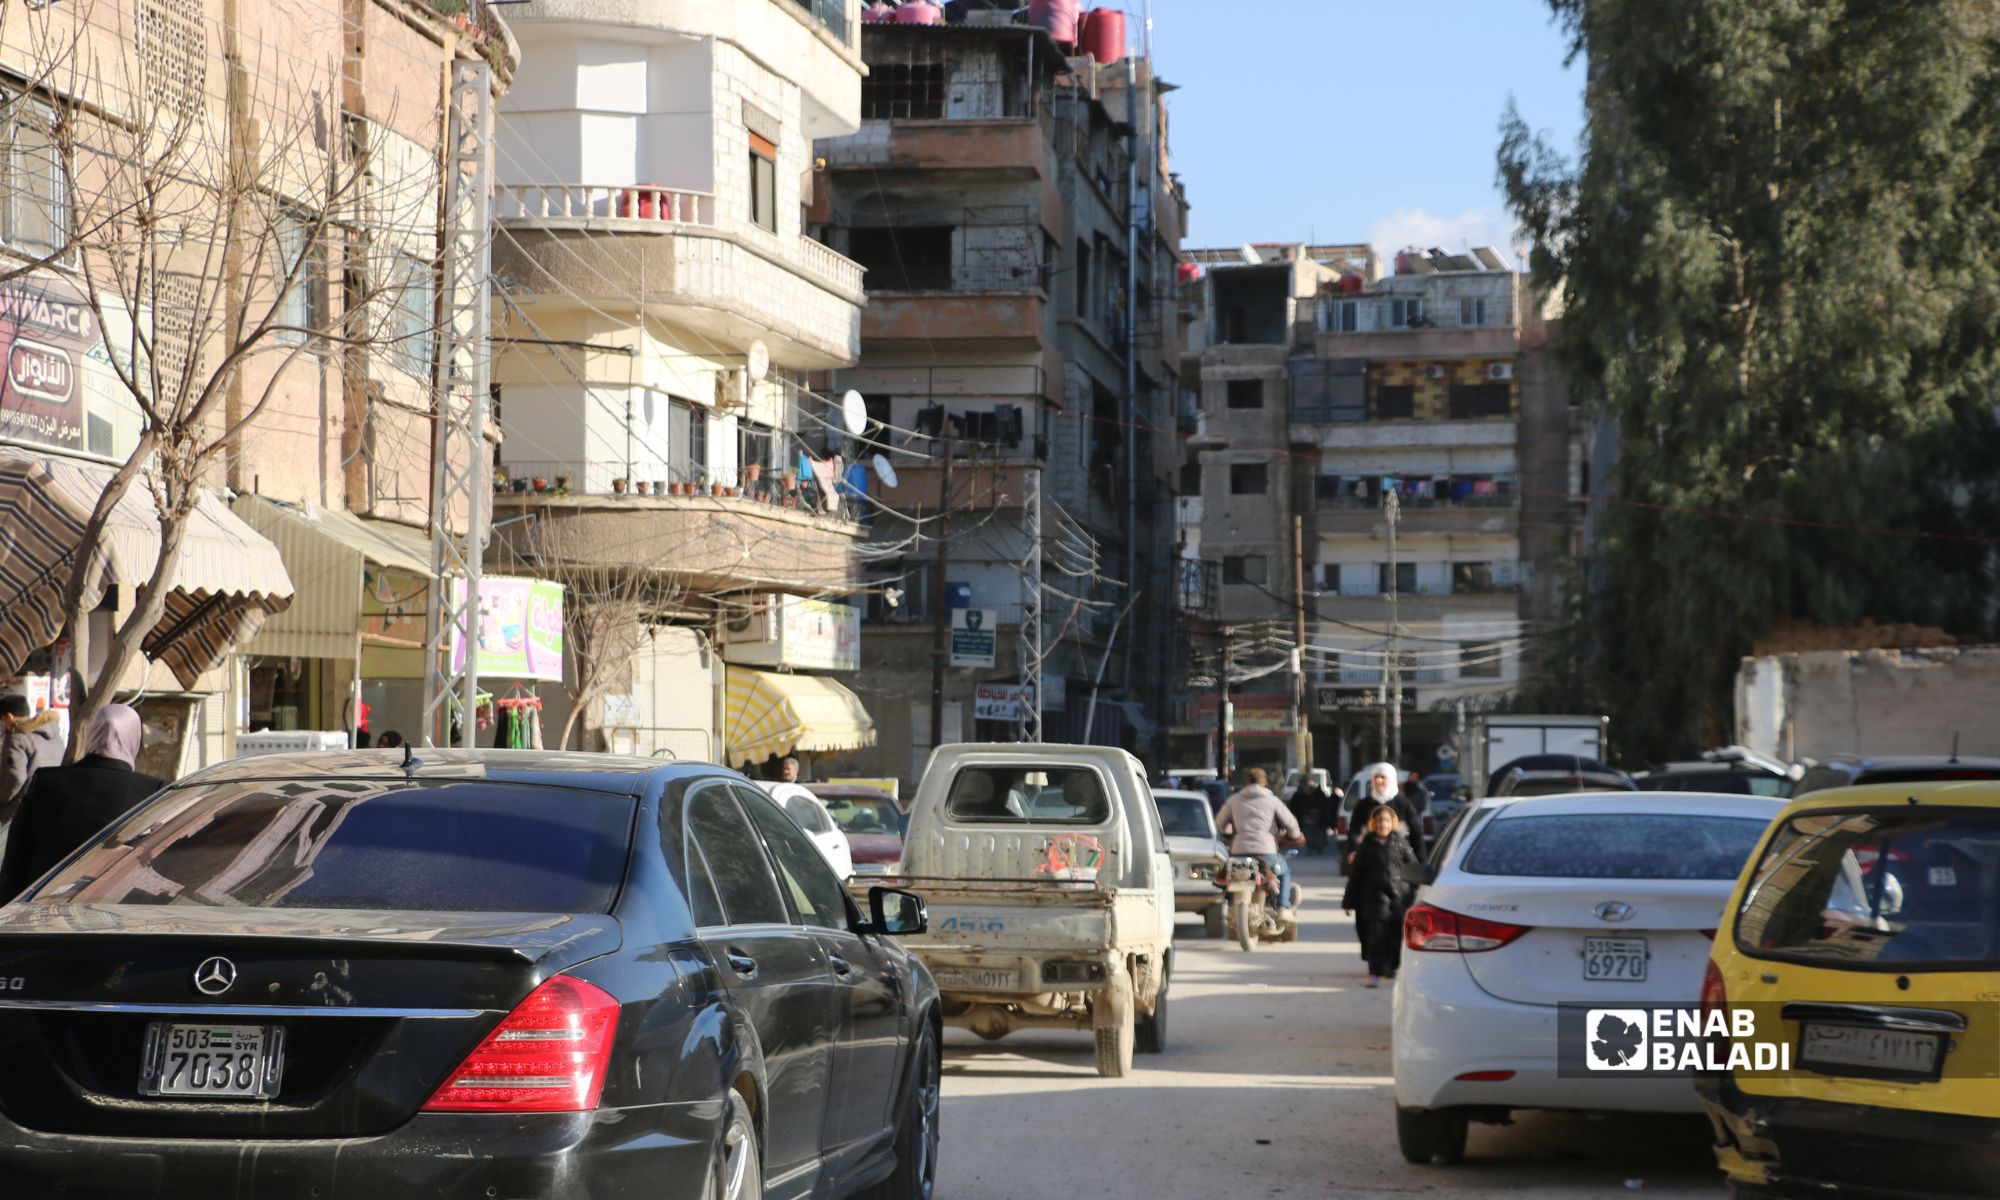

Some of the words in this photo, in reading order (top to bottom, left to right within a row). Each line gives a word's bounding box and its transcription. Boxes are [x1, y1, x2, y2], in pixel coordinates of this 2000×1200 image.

[1588, 955, 1642, 977] 6970
[172, 1029, 211, 1049] 503
[235, 1042, 258, 1050] SYR
[169, 1053, 255, 1090] 7038
